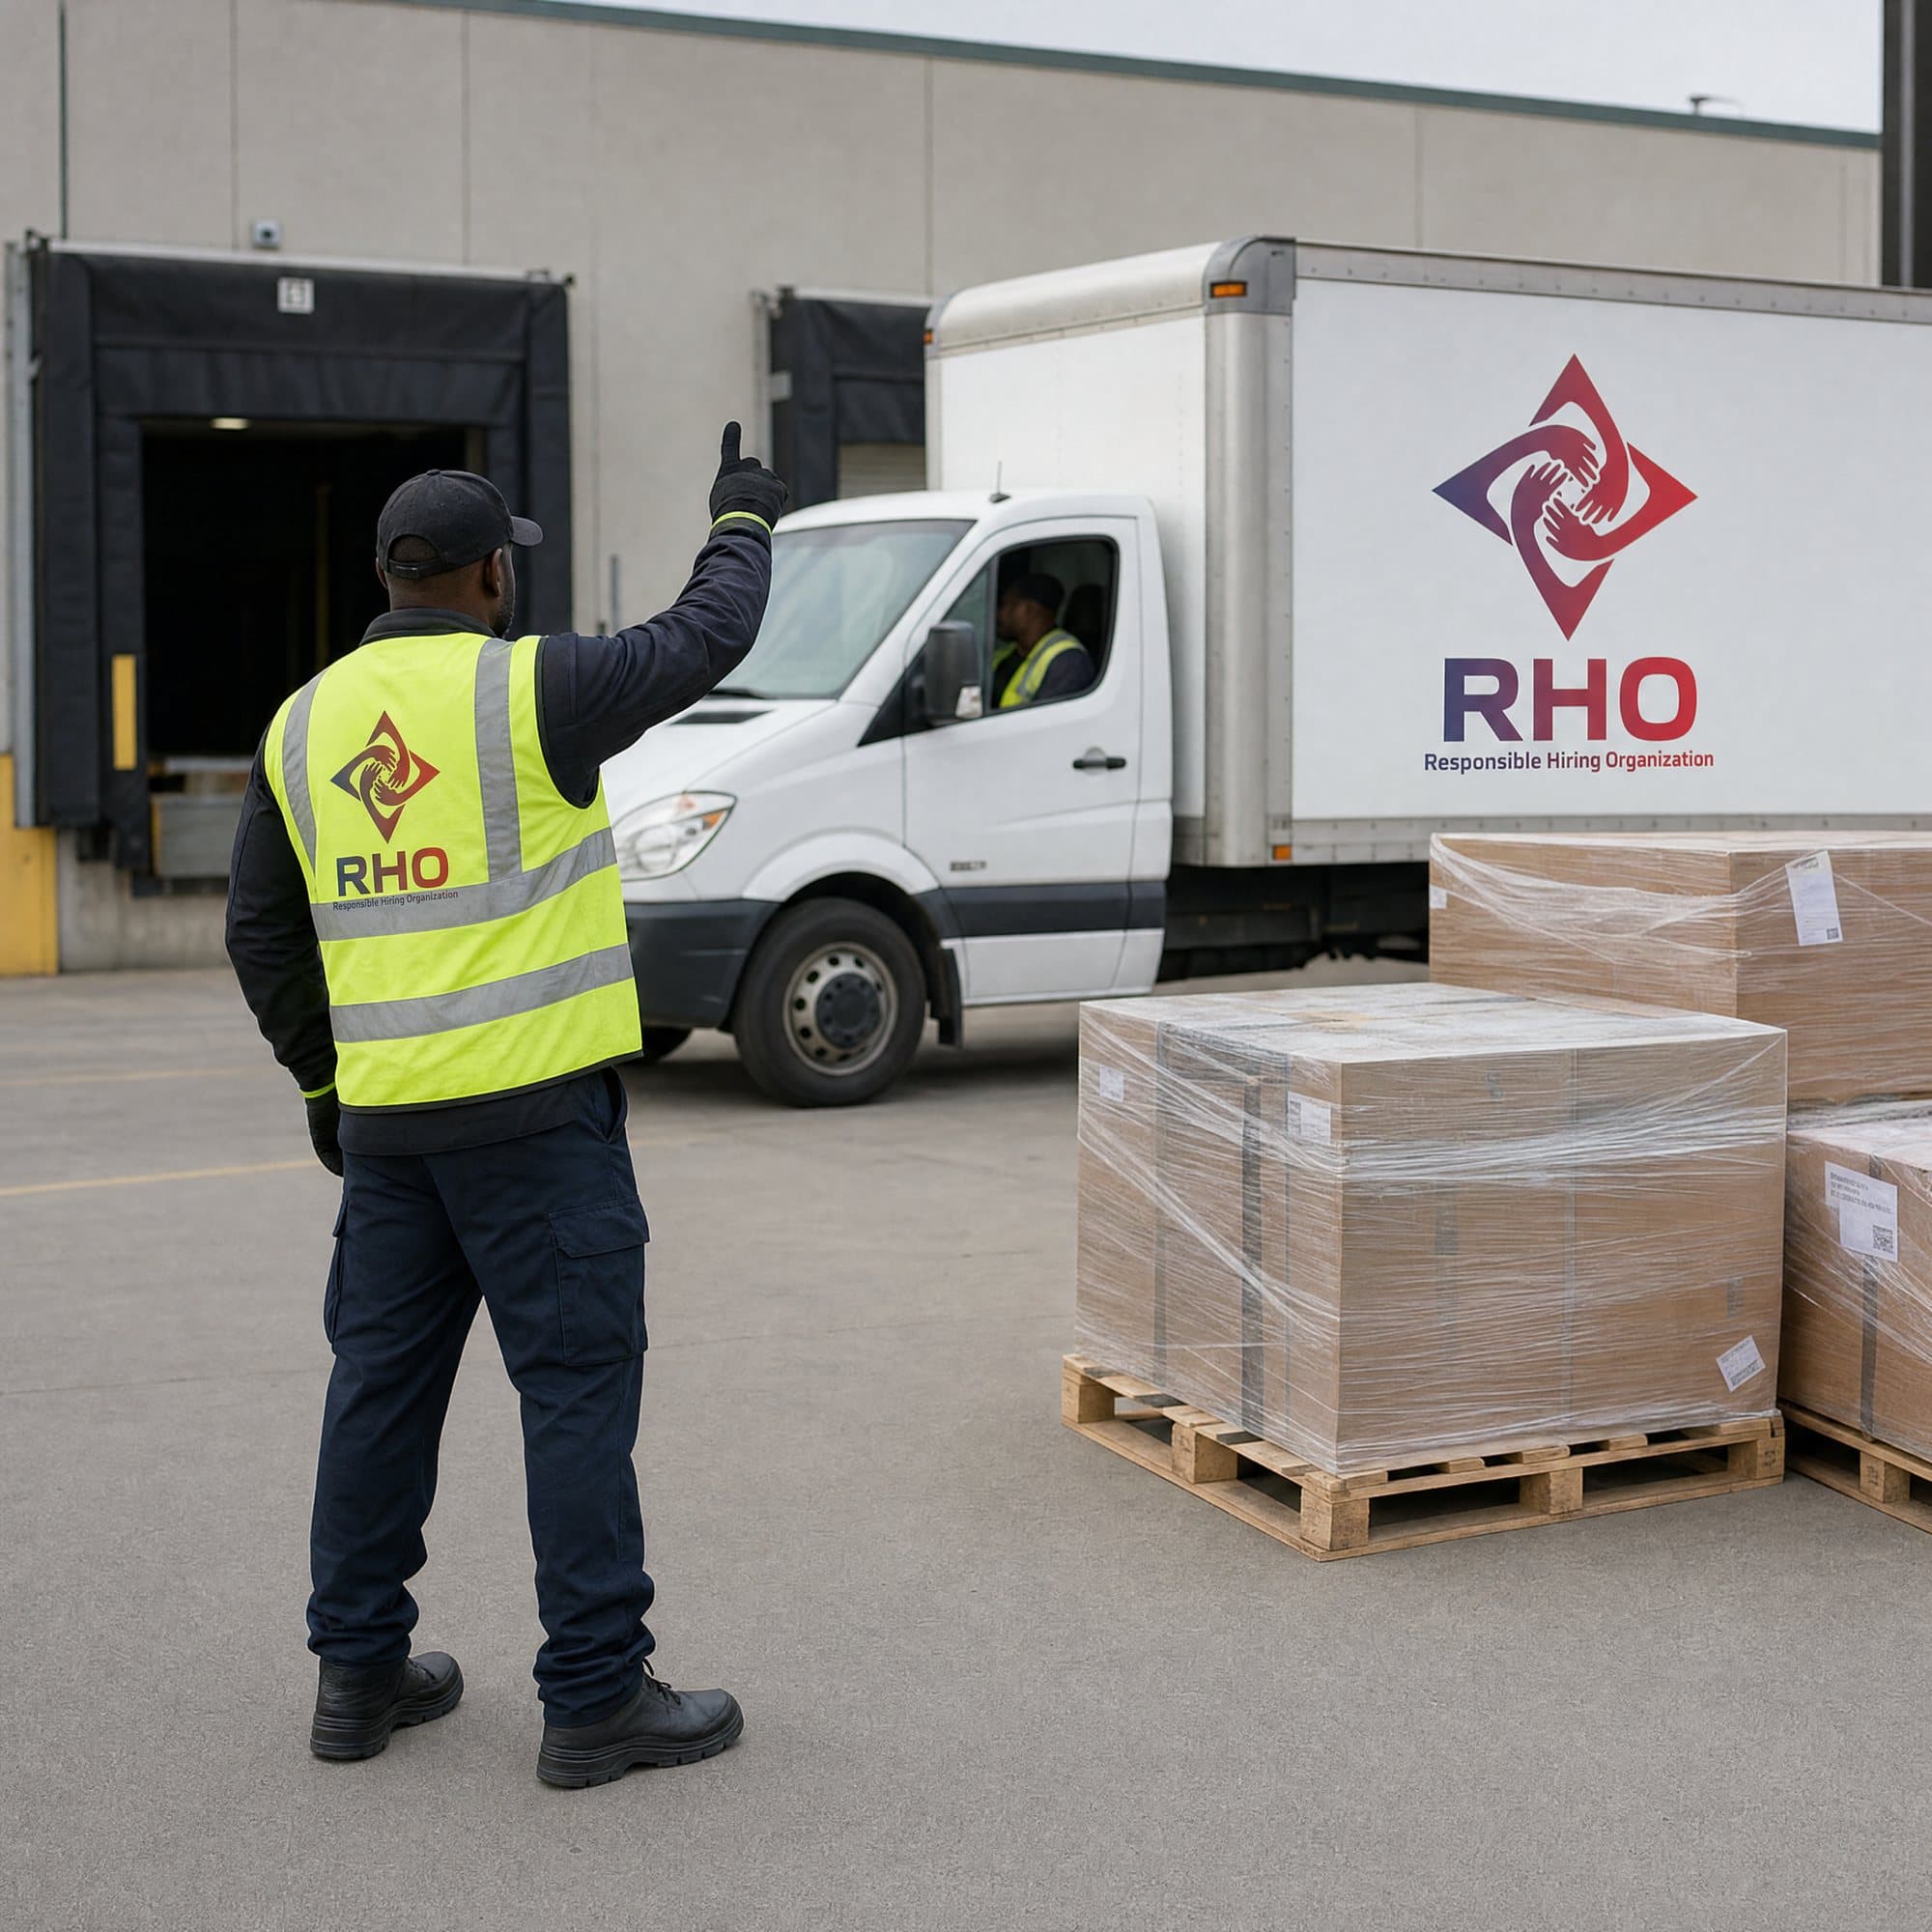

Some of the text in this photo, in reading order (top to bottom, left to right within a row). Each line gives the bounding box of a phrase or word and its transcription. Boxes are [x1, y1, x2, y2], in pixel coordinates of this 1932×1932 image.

[1444, 657, 1697, 742] RHO
[1425, 750, 1715, 776] Responsible Hiring Organization
[336, 846, 449, 897] RHO
[332, 890, 459, 912] Responsible Hiring Organization
